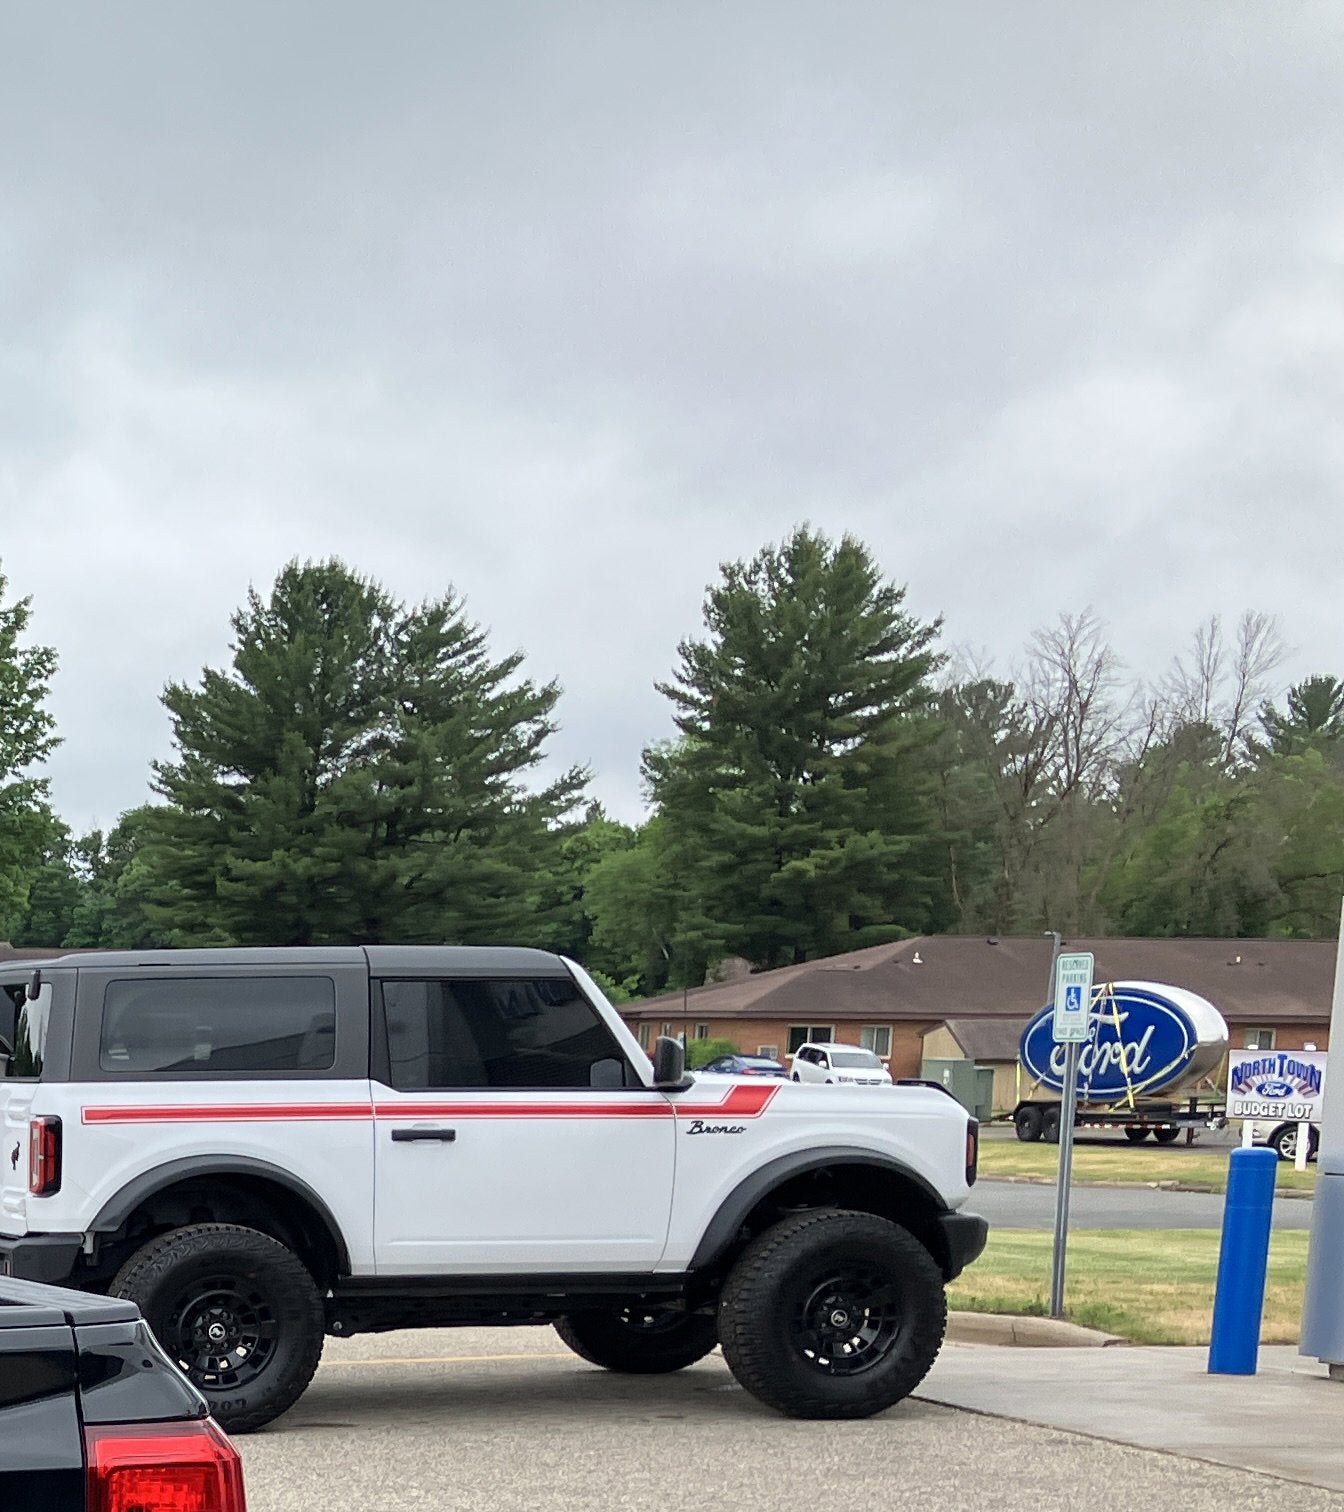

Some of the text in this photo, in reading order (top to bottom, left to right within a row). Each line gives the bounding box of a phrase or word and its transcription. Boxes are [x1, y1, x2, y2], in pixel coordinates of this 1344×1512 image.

[1061, 973, 1088, 983] PARKING
[1050, 1011, 1156, 1077] Ford
[1231, 1057, 1276, 1091] NORTH
[1261, 1082, 1287, 1097] Ford
[1234, 1101, 1313, 1119] BUDGET LOT
[686, 1120, 747, 1135] Bronco
